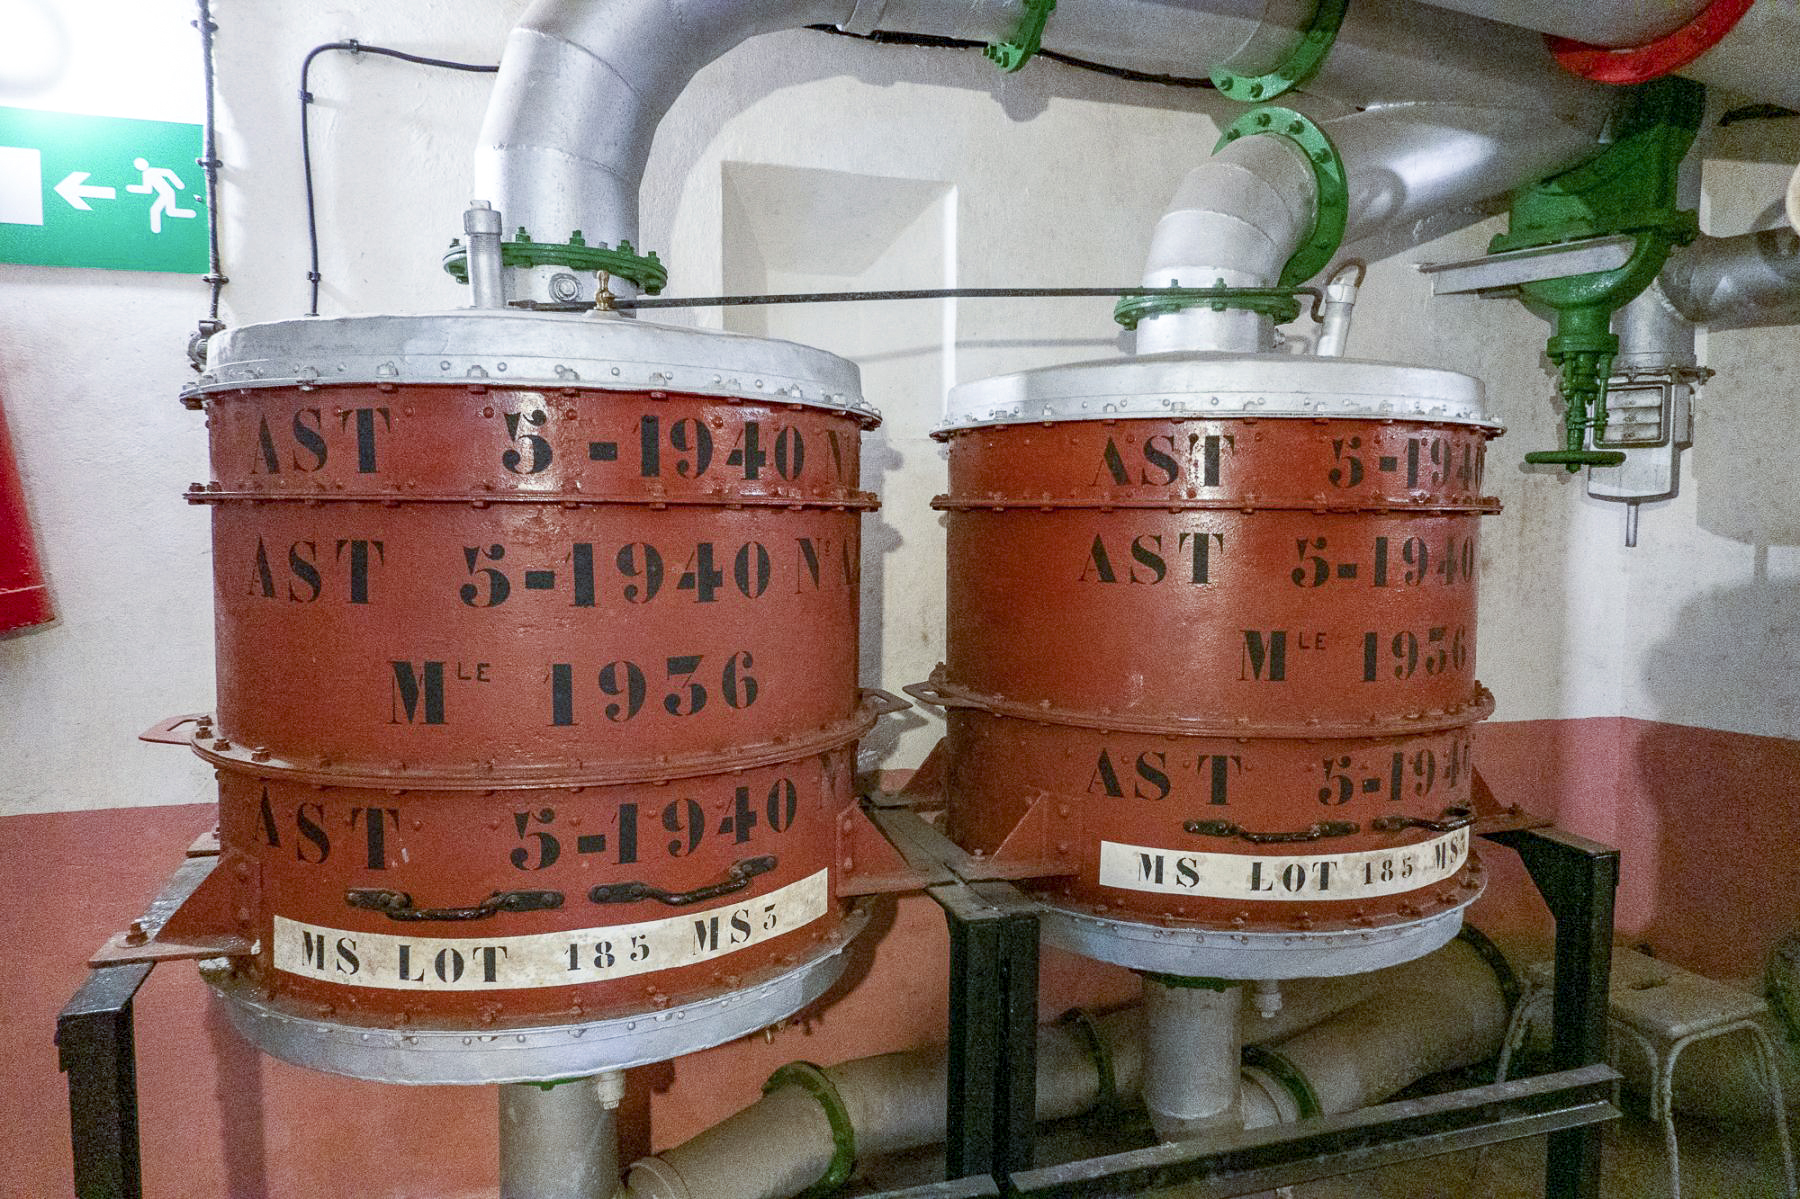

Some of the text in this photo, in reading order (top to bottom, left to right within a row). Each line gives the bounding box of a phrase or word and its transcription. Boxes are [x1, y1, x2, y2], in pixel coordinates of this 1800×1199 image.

[251, 407, 391, 475] AST
[1090, 433, 1235, 487] AST
[247, 535, 384, 605] AST
[1078, 532, 1223, 586] AST
[1360, 625, 1467, 682] 1936
[544, 650, 759, 727] 1936
[1087, 747, 1242, 806] AST
[252, 784, 399, 870] AST
[1138, 853, 1200, 888] MS
[1250, 861, 1337, 892] LOT
[1364, 856, 1413, 885] 185
[302, 930, 360, 975] MS
[398, 944, 508, 983] LOT
[565, 935, 650, 971] 185
